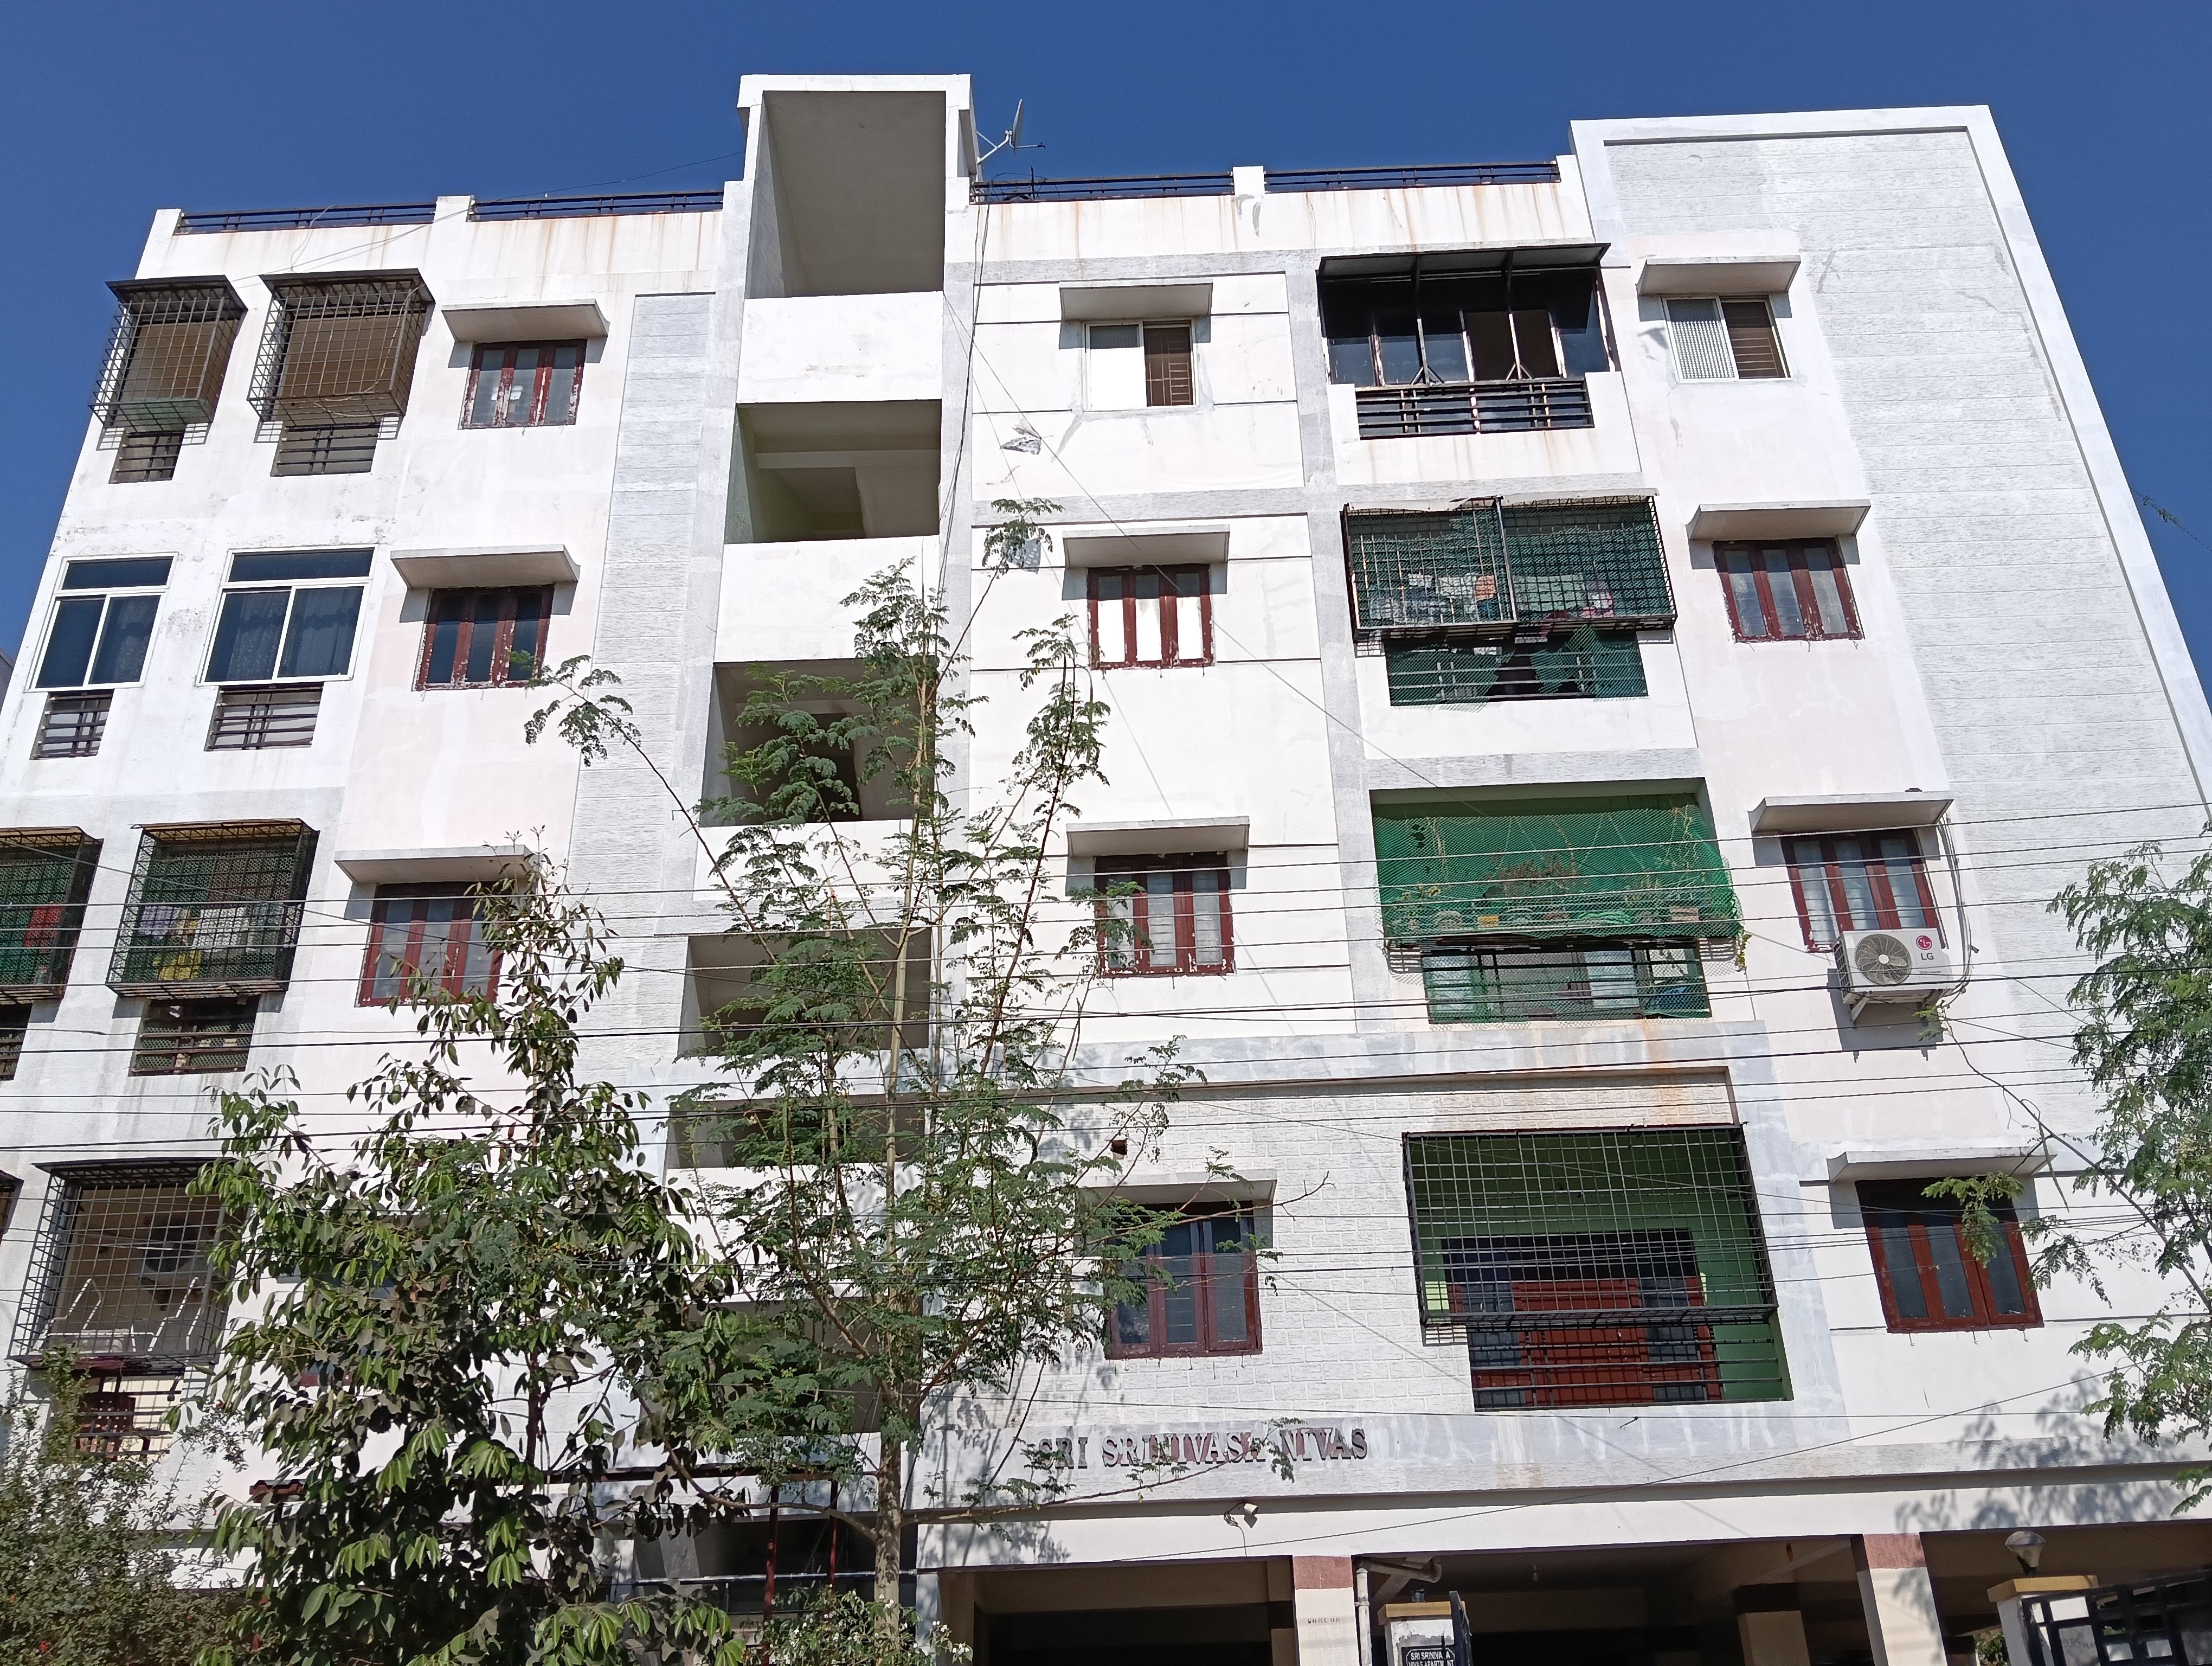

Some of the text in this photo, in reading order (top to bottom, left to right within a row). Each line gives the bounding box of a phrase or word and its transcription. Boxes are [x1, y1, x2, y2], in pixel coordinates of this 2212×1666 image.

[1920, 952, 1934, 960] LG
[1038, 1427, 1368, 1469] SRI SRINIVASA NIVAS
[1411, 1651, 1451, 1661] SRI SRINIVAA
